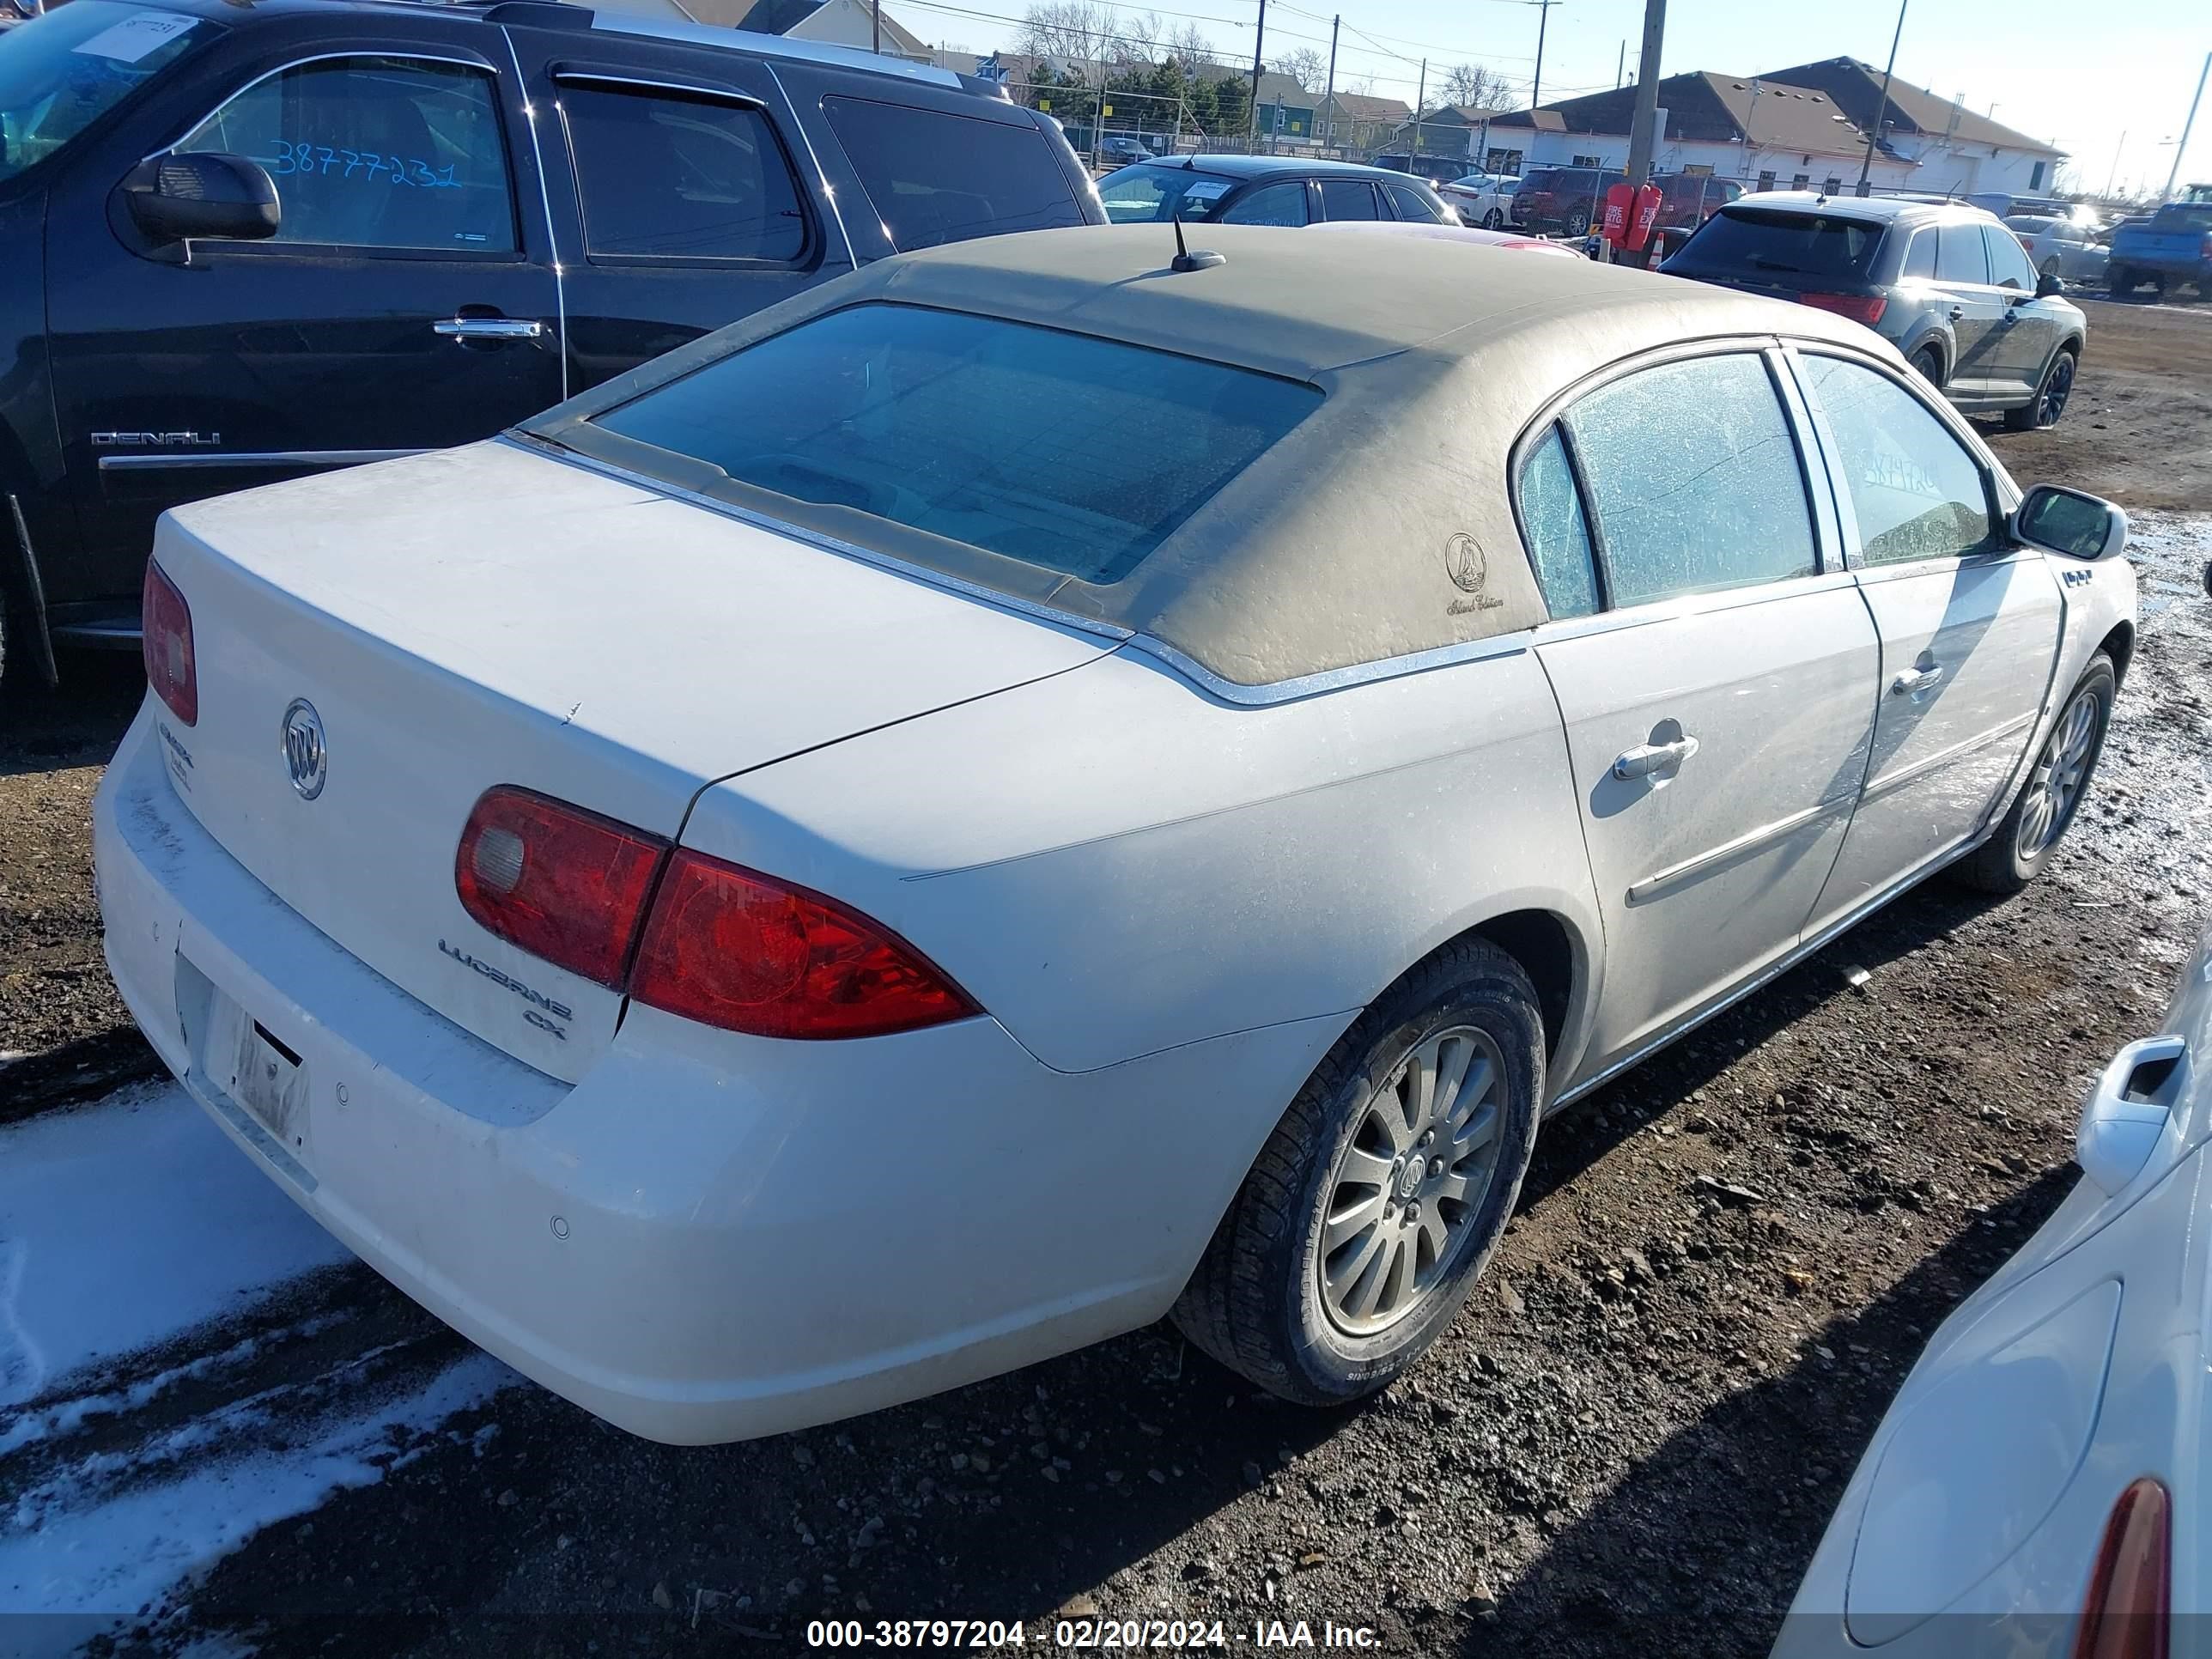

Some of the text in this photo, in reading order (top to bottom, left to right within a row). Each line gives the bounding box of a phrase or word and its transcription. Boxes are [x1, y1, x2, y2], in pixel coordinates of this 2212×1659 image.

[270, 139, 463, 188] 38777231
[1608, 205, 1624, 216] FIRE
[90, 432, 221, 446] DENALI
[438, 938, 574, 1022] LUCERNE
[522, 1010, 567, 1042] CX
